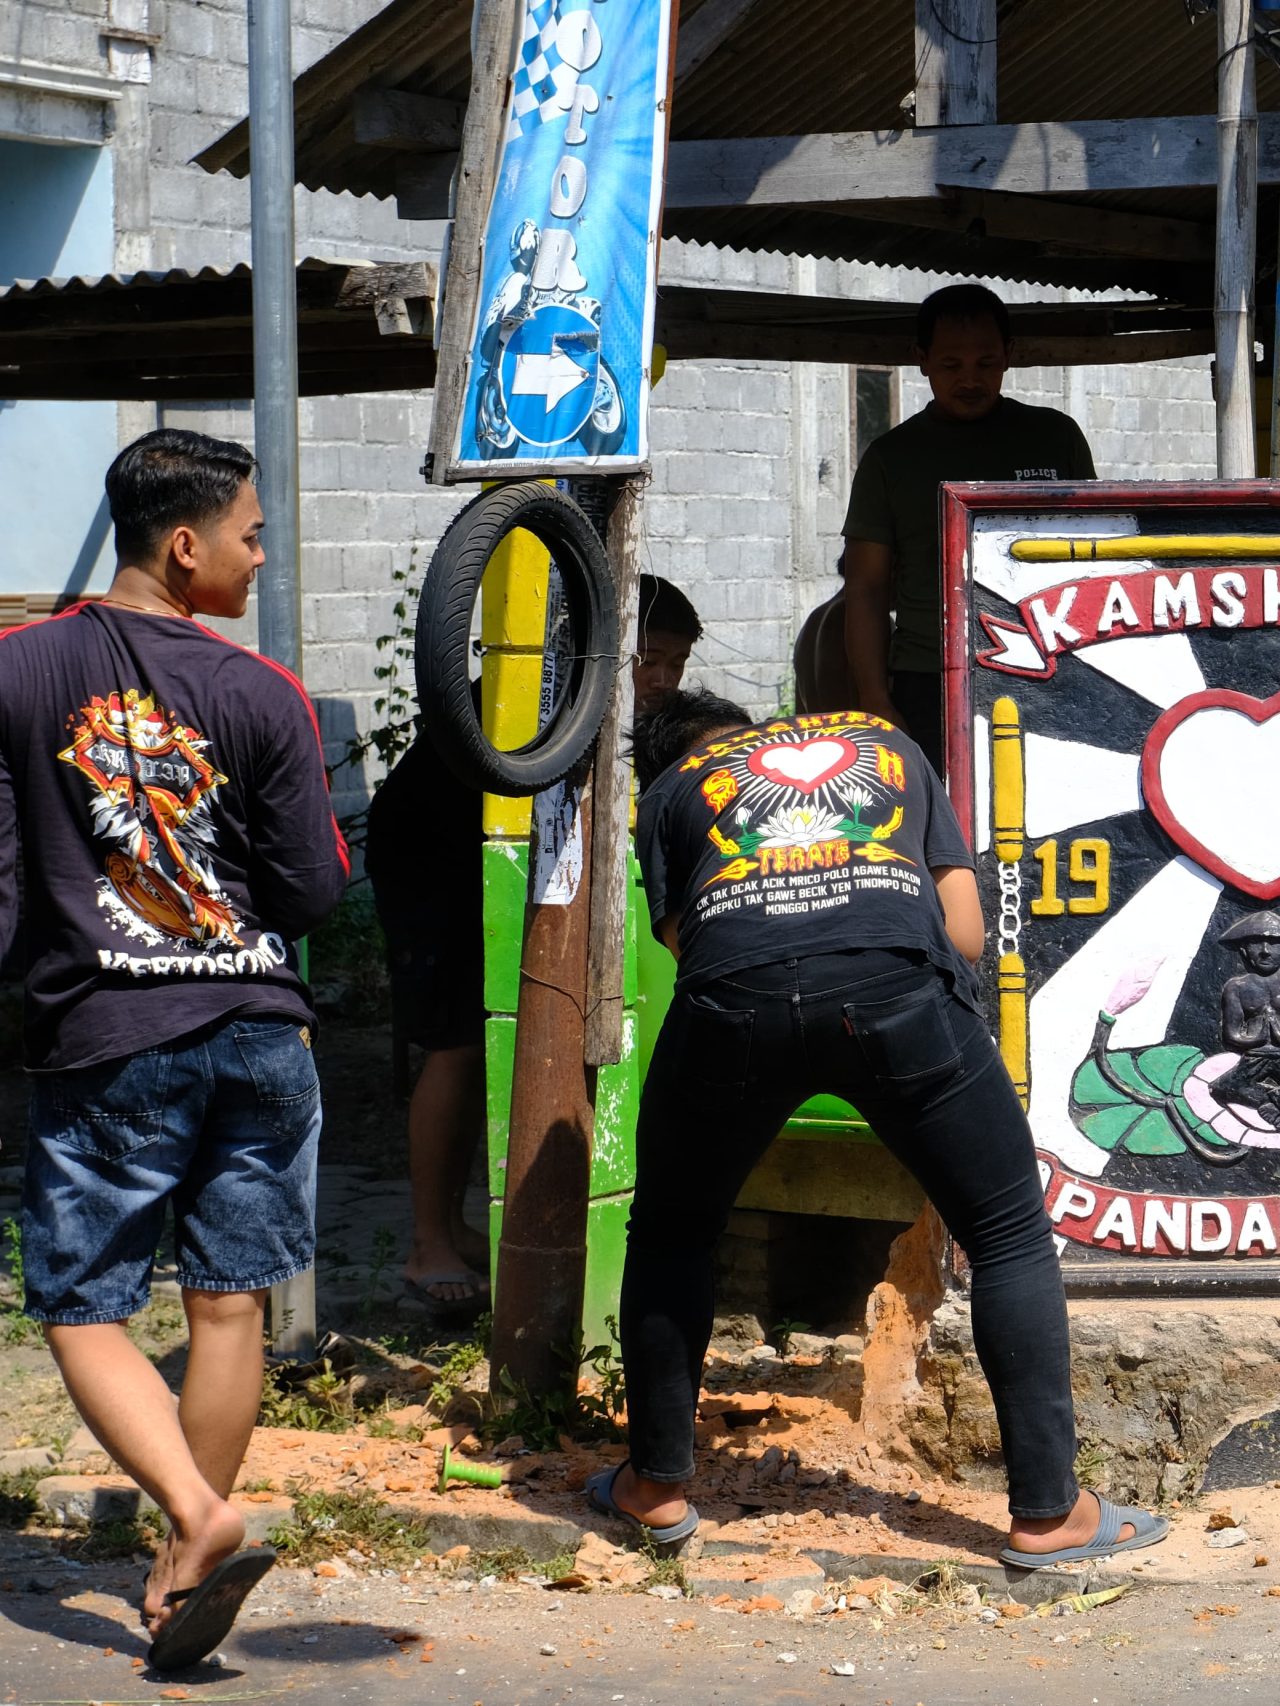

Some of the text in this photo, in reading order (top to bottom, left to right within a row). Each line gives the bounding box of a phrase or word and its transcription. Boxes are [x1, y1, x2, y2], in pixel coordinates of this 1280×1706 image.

[531, 0, 608, 292] OTOR
[1014, 468, 1058, 480] POLICE
[541, 655, 555, 684] 8877
[540, 687, 553, 716] 3555
[756, 838, 851, 877] TERATE
[1030, 836, 1111, 916] 19
[700, 897, 742, 922] KAREPKU
[744, 892, 764, 907] TAK
[766, 890, 797, 903] GAWE
[798, 884, 828, 899] BECIK
[832, 880, 852, 895] YEN
[854, 878, 900, 891] TINOMPO
[711, 888, 728, 903] TAK
[731, 880, 759, 898] OCAK
[762, 876, 786, 890] ACIK
[788, 874, 821, 888] MRICO
[823, 867, 850, 882] POLO
[852, 864, 889, 877] AGAWE
[890, 866, 922, 887] DAKON
[765, 893, 850, 917] MONGGO MAWON
